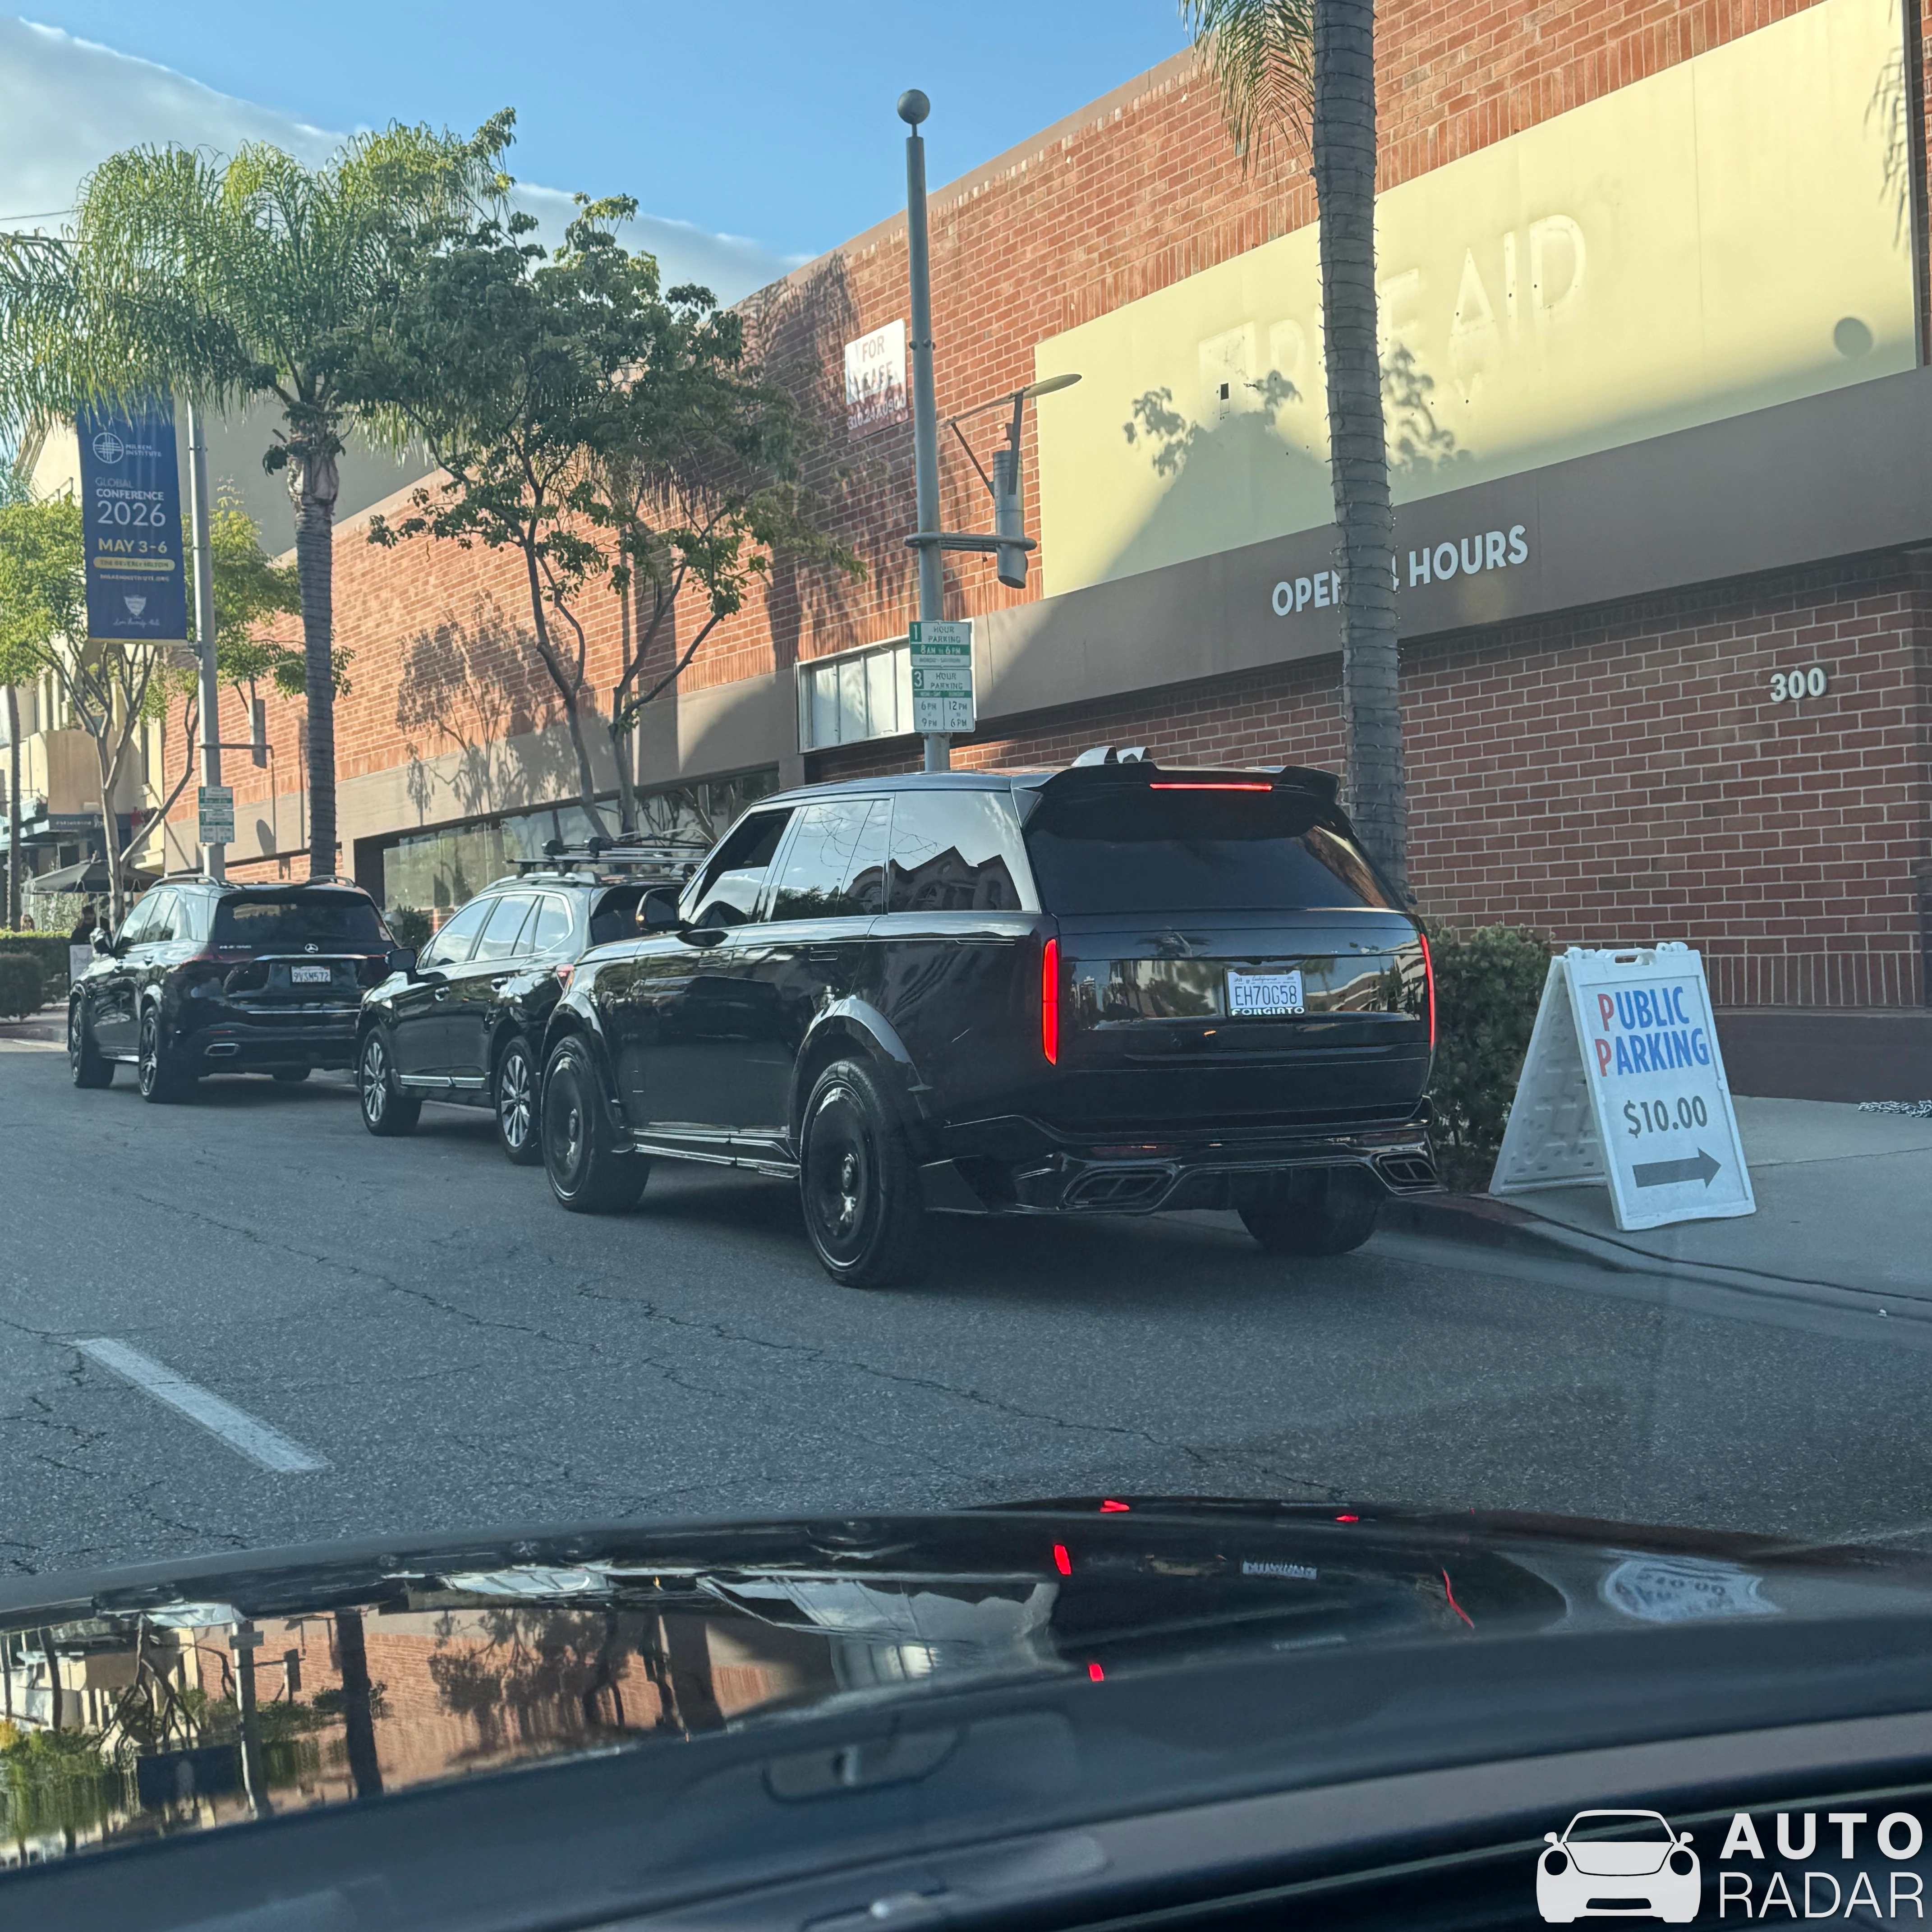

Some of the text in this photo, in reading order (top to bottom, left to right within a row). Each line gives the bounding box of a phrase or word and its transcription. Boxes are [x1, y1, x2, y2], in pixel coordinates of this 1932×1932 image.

[1449, 214, 1587, 358] AID
[862, 335, 885, 363] FOR
[854, 361, 893, 392] EASE
[95, 477, 135, 488] GLOBAL
[96, 488, 165, 501] CONFERENCE
[97, 500, 166, 527] 2026
[98, 538, 134, 553] MAY
[1409, 525, 1528, 587] HOURS
[914, 625, 917, 640] 1
[914, 671, 922, 687] 3
[1770, 667, 1826, 702] 300
[1235, 985, 1297, 1006] EH70G58
[1597, 986, 1689, 1031] PUBLIC
[1232, 1007, 1305, 1016] FORGIATO
[1595, 1028, 1710, 1077] PARKING
[1624, 1095, 1707, 1138] $10.00
